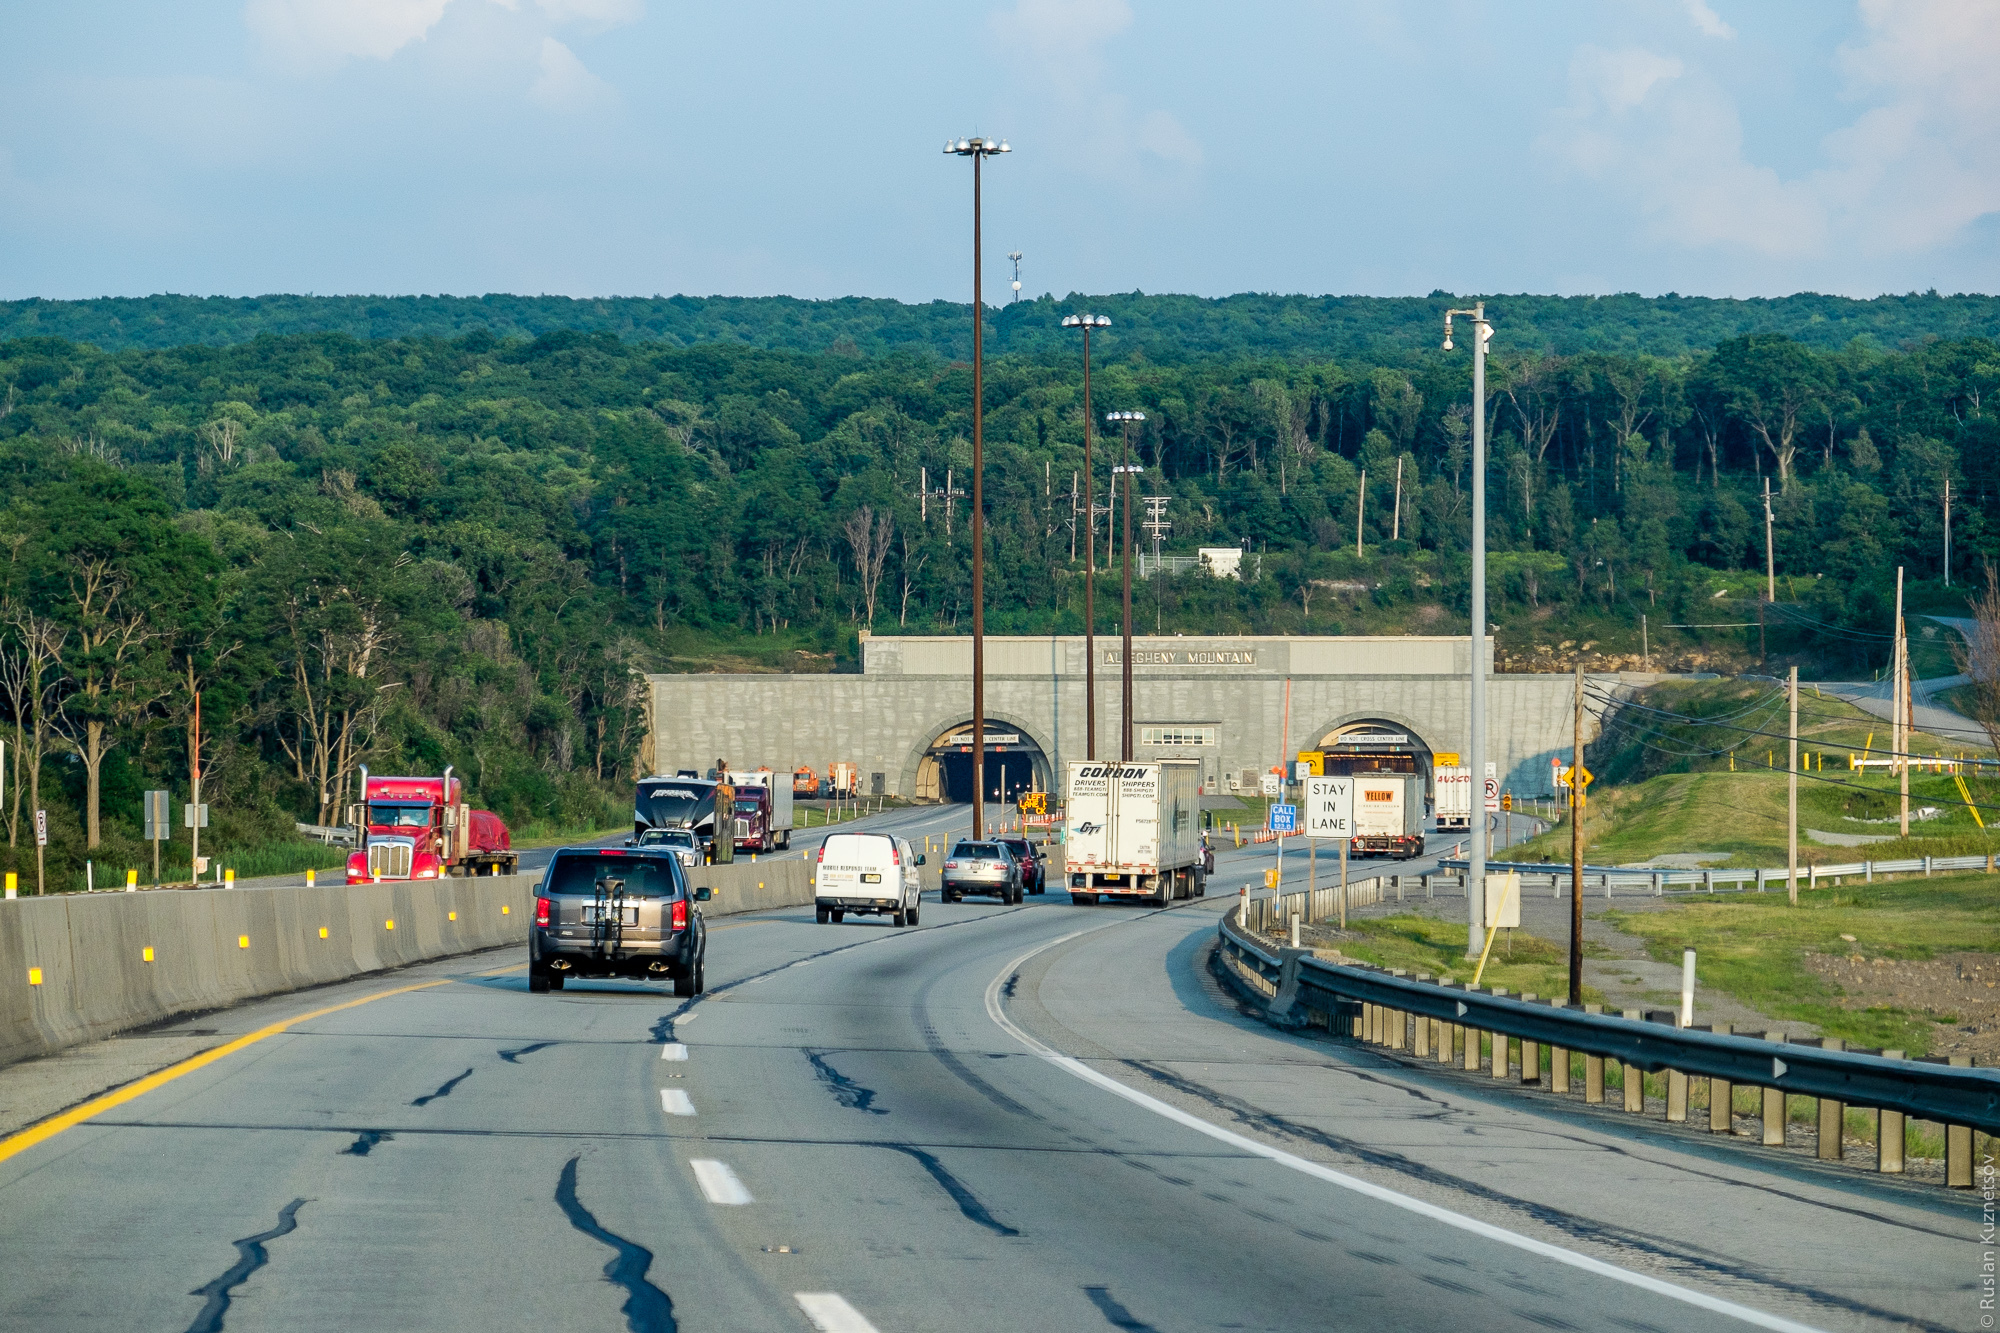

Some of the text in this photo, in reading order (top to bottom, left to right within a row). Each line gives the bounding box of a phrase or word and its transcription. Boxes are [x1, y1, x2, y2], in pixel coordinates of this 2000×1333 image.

[1105, 652, 1253, 664] ALEGHENY MOUNTAIN
[1265, 784, 1278, 793] 55
[1313, 783, 1347, 796] STAY
[1026, 793, 1046, 801] LEFT
[1366, 792, 1392, 801] YELLOW
[1019, 800, 1040, 808] LANE
[1323, 801, 1336, 813] IN
[1272, 806, 1294, 815] CALL
[1274, 814, 1292, 824] BOX
[1312, 818, 1346, 830] LANE
